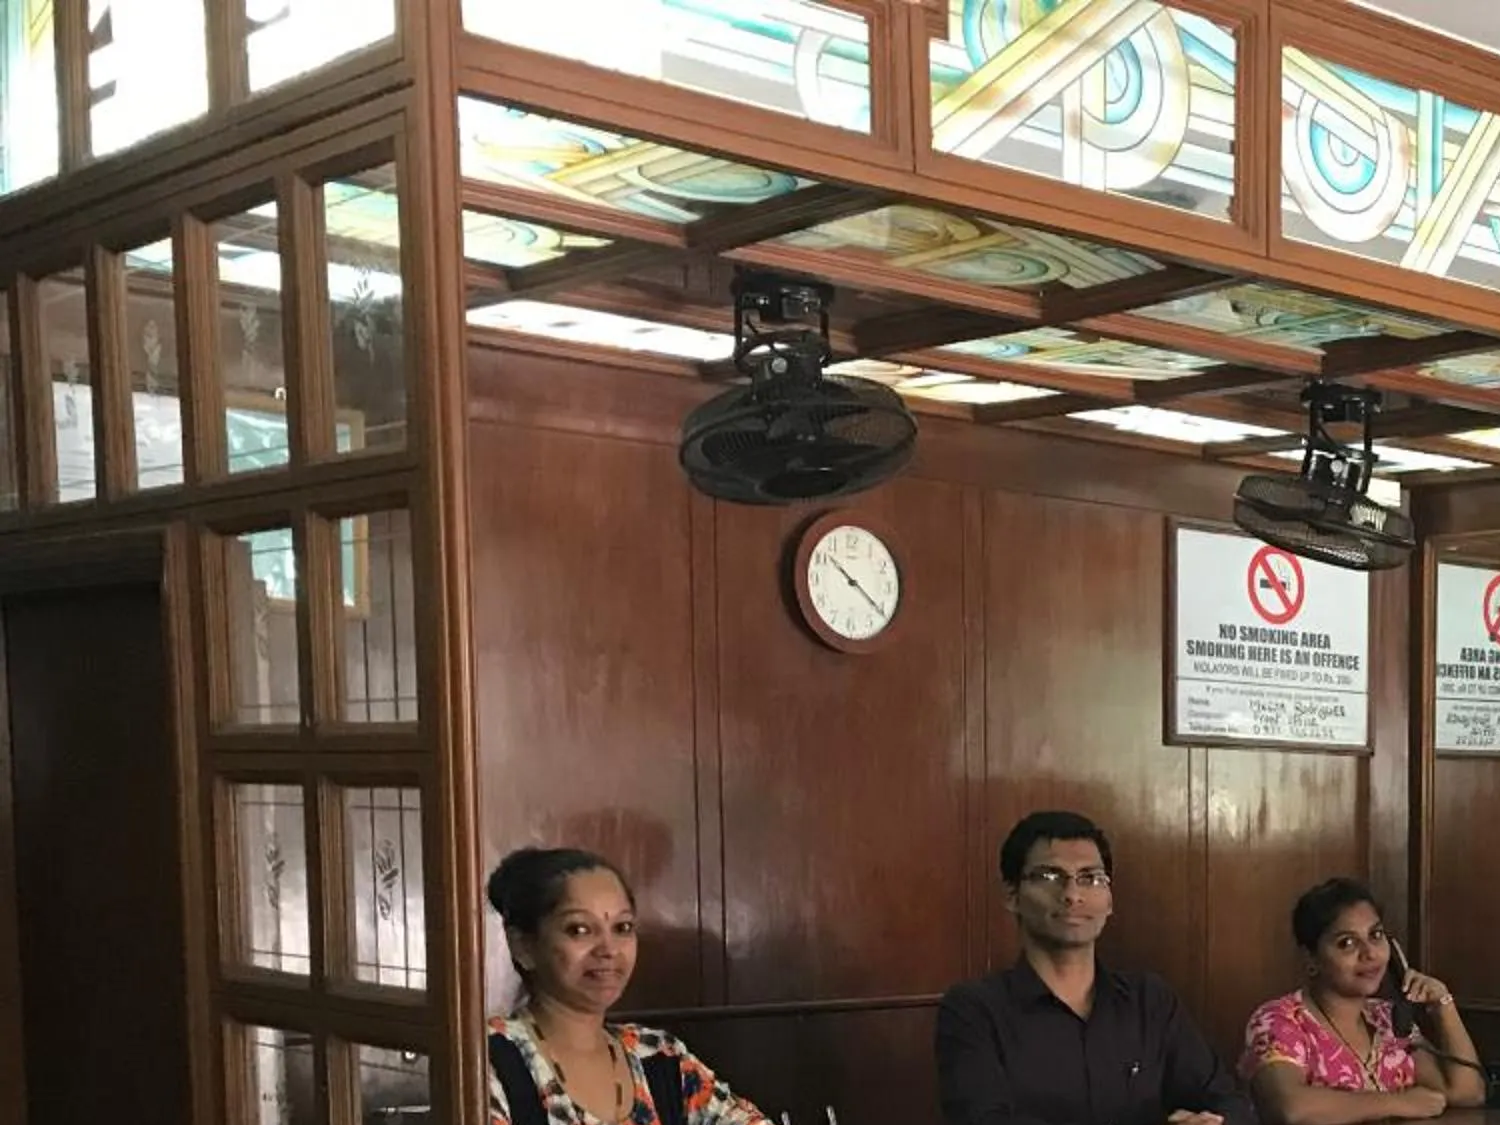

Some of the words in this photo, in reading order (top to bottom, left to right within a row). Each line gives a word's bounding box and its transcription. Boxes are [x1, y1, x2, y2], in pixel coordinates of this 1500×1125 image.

[1219, 623, 1237, 640] NO
[1239, 625, 1299, 647] SMOKING
[1301, 631, 1331, 649] AREA
[1186, 639, 1246, 660] SMOKING
[1248, 644, 1277, 663] HERE
[1280, 649, 1292, 665] IS
[1294, 650, 1310, 666] AN
[1312, 651, 1360, 671] OFFENCE
